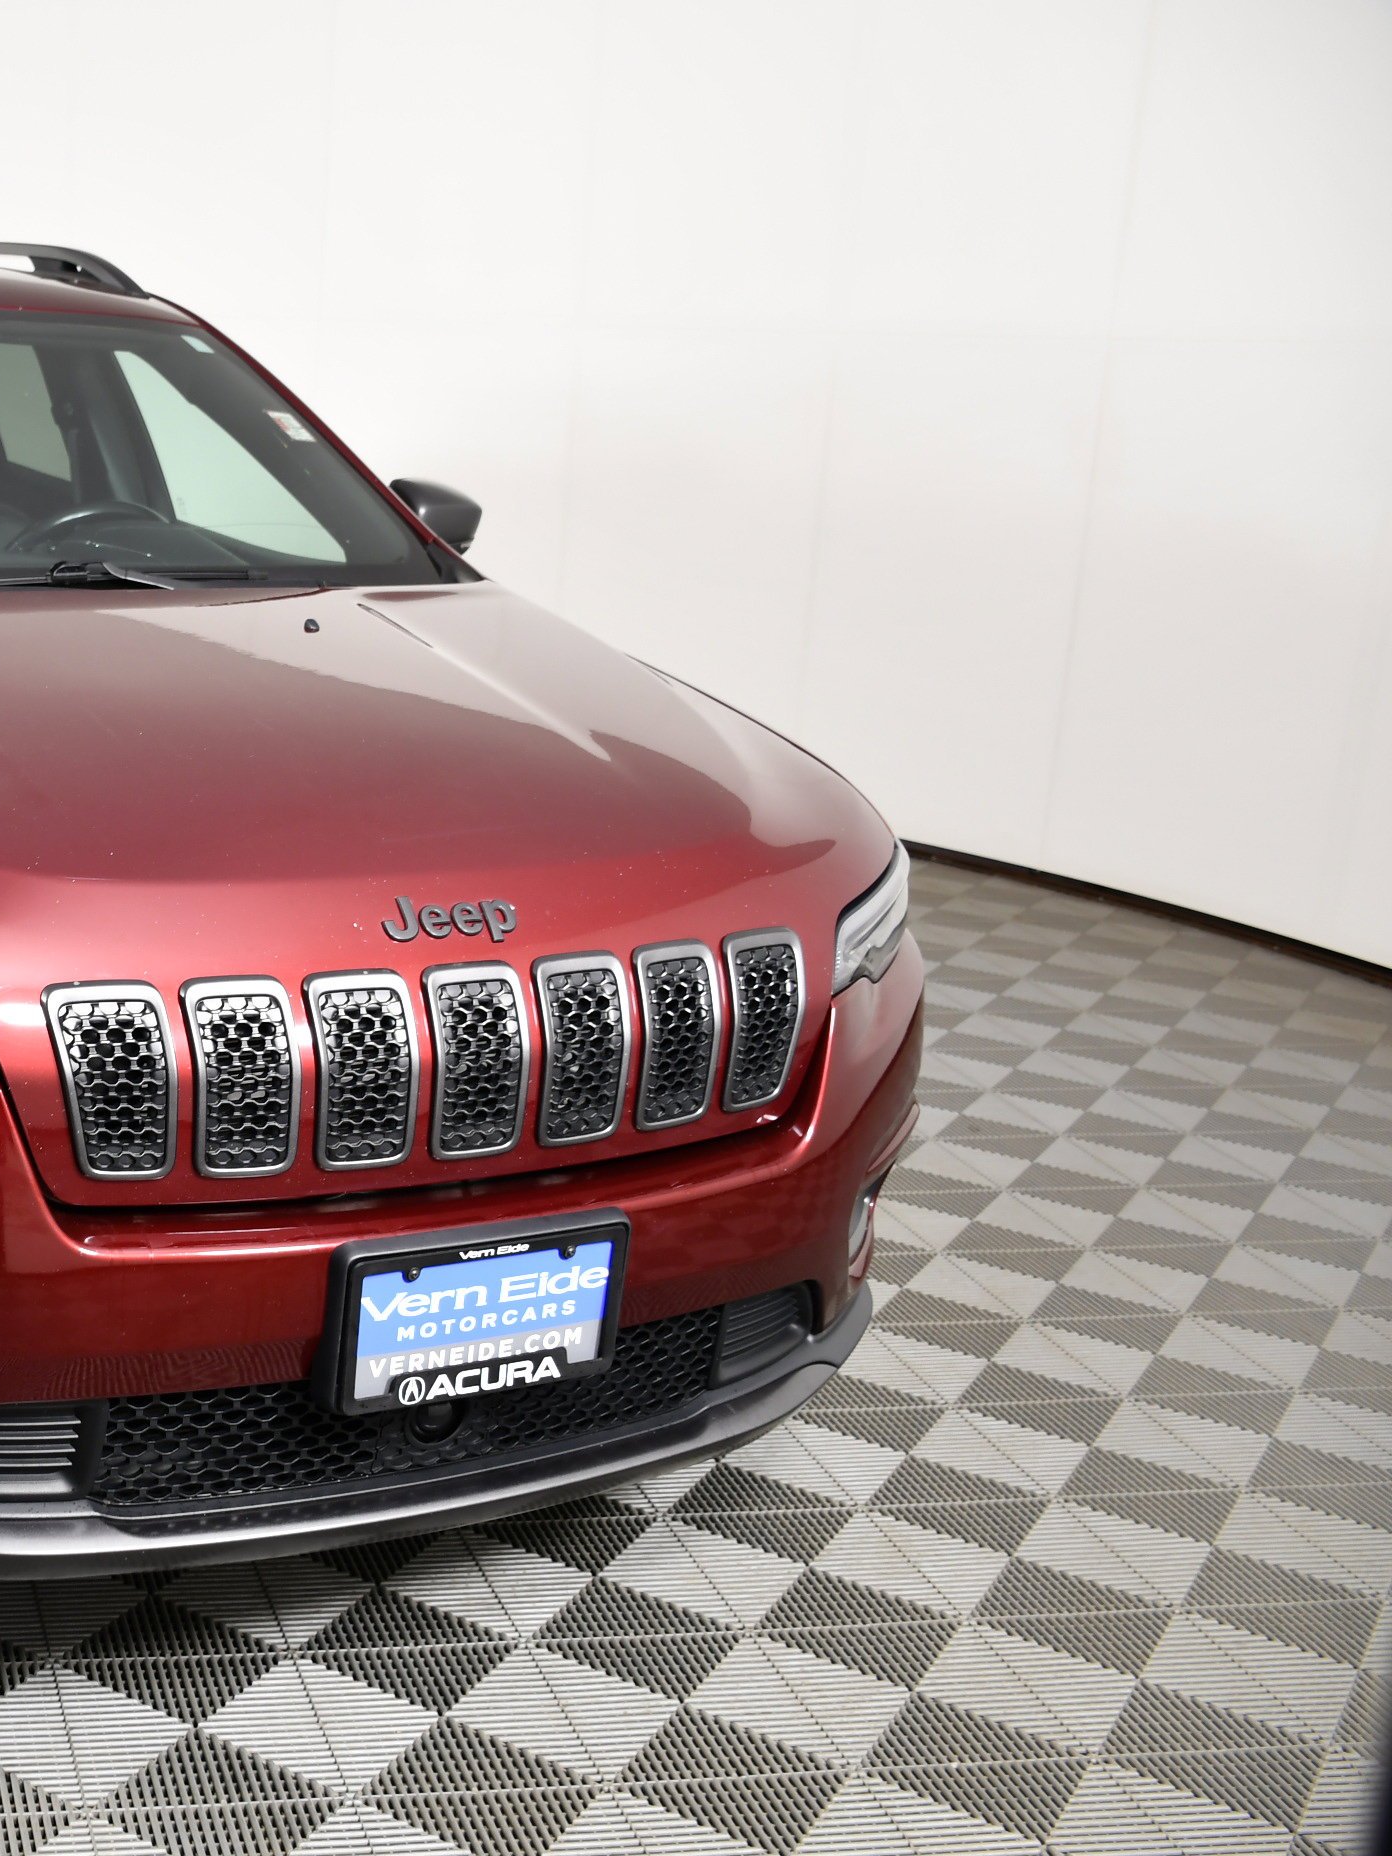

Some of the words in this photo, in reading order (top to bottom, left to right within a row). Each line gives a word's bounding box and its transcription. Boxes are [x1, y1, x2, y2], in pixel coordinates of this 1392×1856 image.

[381, 896, 517, 943] Jeep
[459, 1249, 495, 1260] Vern
[497, 1243, 530, 1255] Eide
[360, 1284, 488, 1322] Vern
[498, 1265, 610, 1303] Eide
[396, 1299, 577, 1342] MOTORCARS
[369, 1326, 582, 1378] VERNEIDE.COM
[425, 1356, 561, 1401] ACURA
